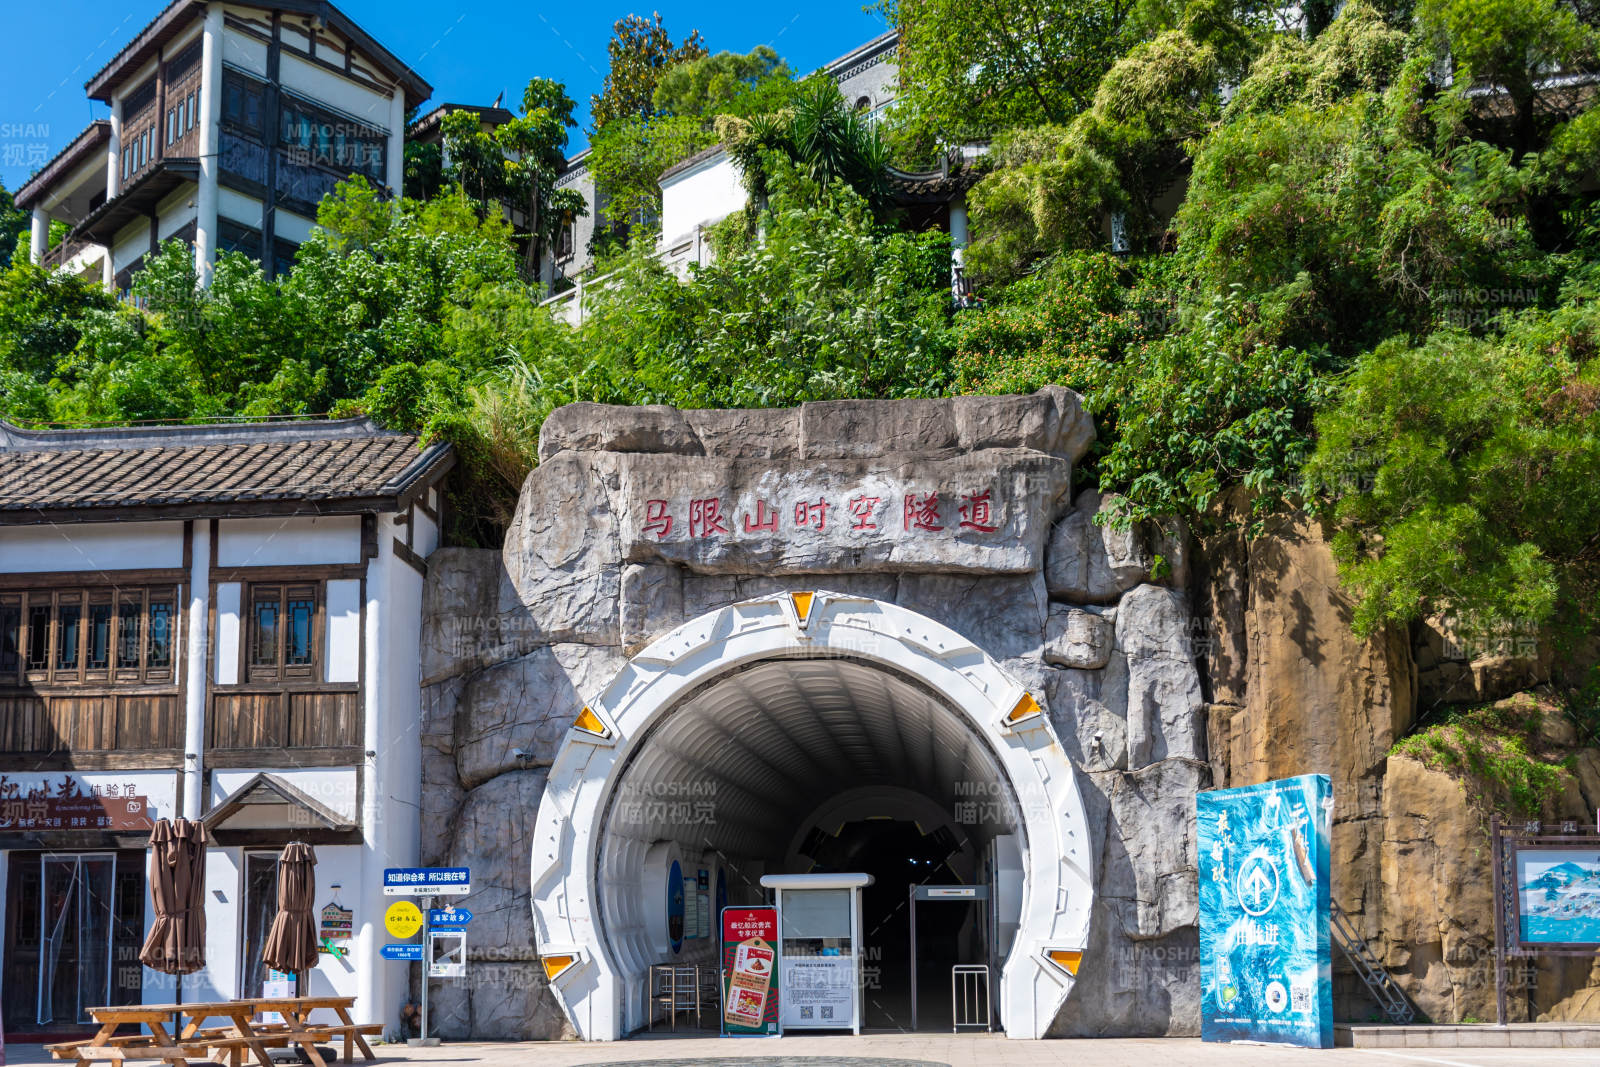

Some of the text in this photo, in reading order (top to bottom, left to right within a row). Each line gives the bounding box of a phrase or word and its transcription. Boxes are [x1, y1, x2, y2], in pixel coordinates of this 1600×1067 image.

[641, 491, 999, 538] 马限山时空隧道
[90, 783, 137, 800] 体验馆
[387, 871, 467, 882] 知道你会来 所以我在等
[737, 929, 765, 937] 专享优惠
